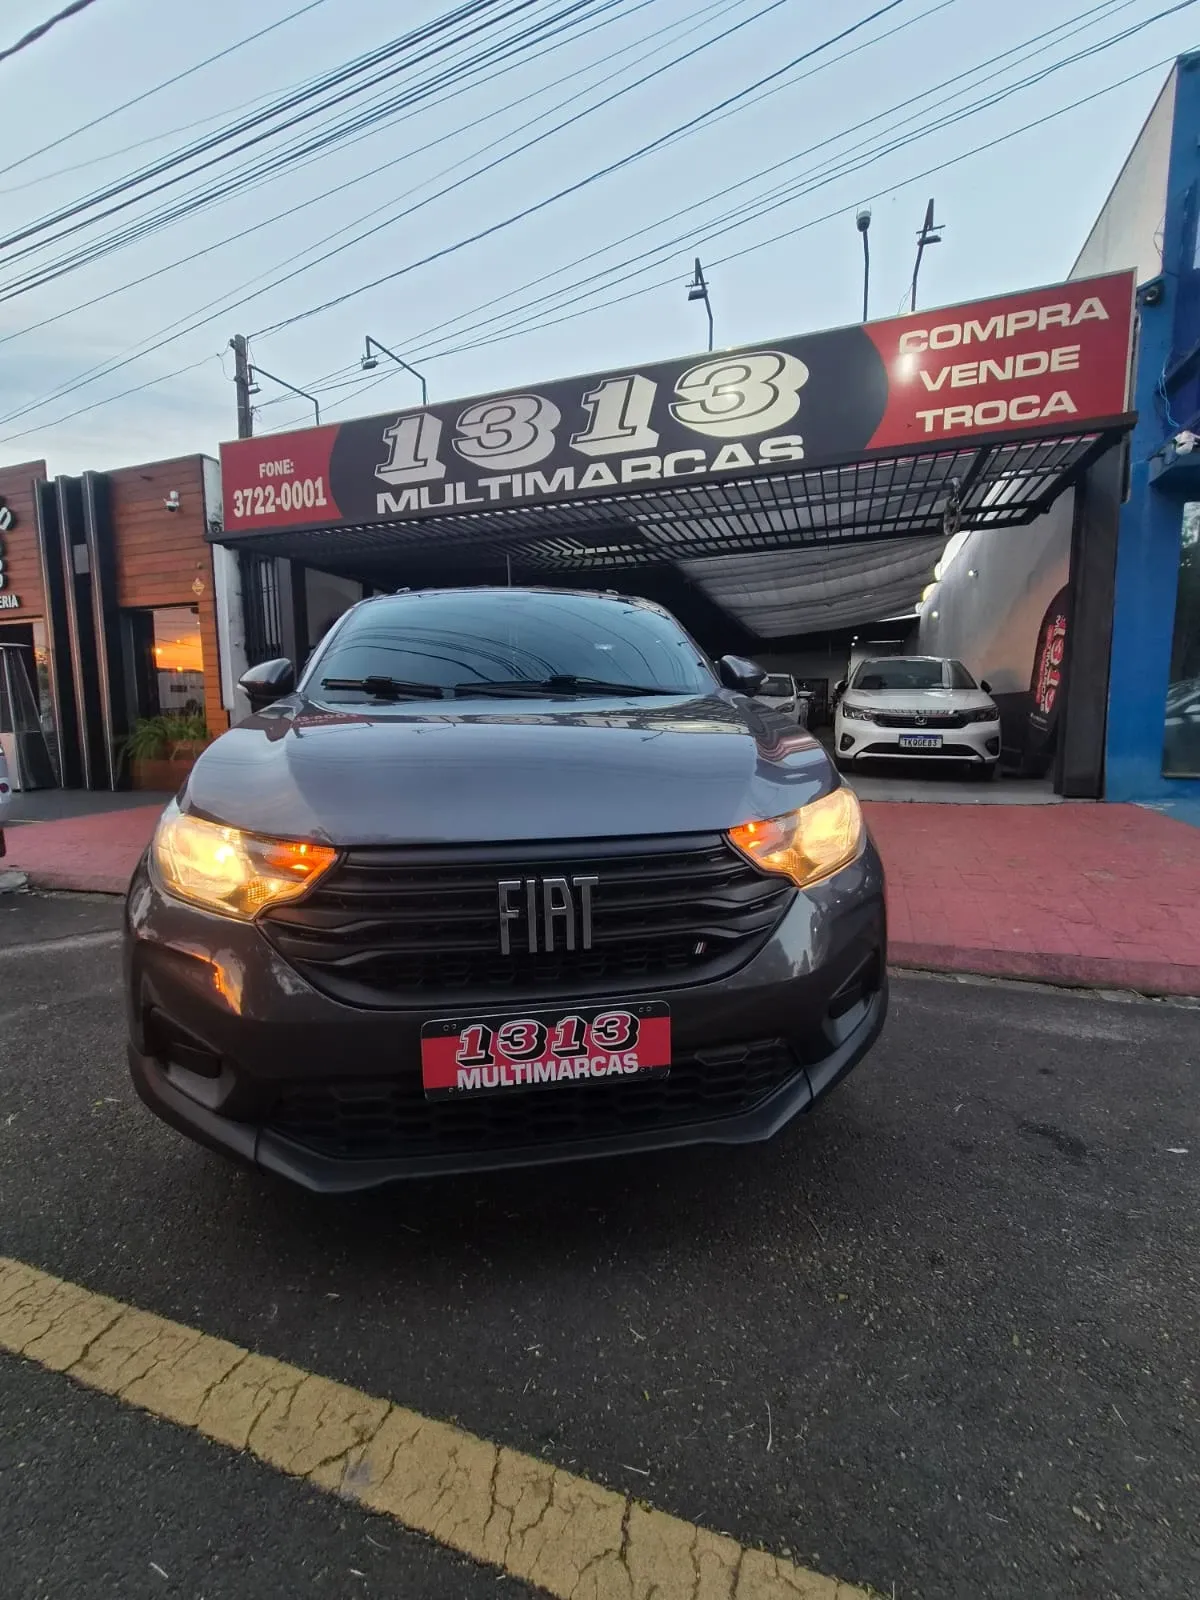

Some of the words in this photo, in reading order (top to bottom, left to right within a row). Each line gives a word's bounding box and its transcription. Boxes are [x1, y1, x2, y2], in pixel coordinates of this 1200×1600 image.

[900, 297, 1109, 354] COMPRA
[920, 345, 1081, 391] VENDE
[374, 351, 810, 485] 1313
[916, 390, 1078, 432] TROCA
[259, 458, 294, 478] FONE:
[376, 434, 805, 514] MULTIMARCAS
[233, 476, 327, 517] 3722-0001
[498, 876, 598, 955] FIAT
[456, 1010, 641, 1068] 1313
[457, 1052, 639, 1090] MULTIMARCAS
